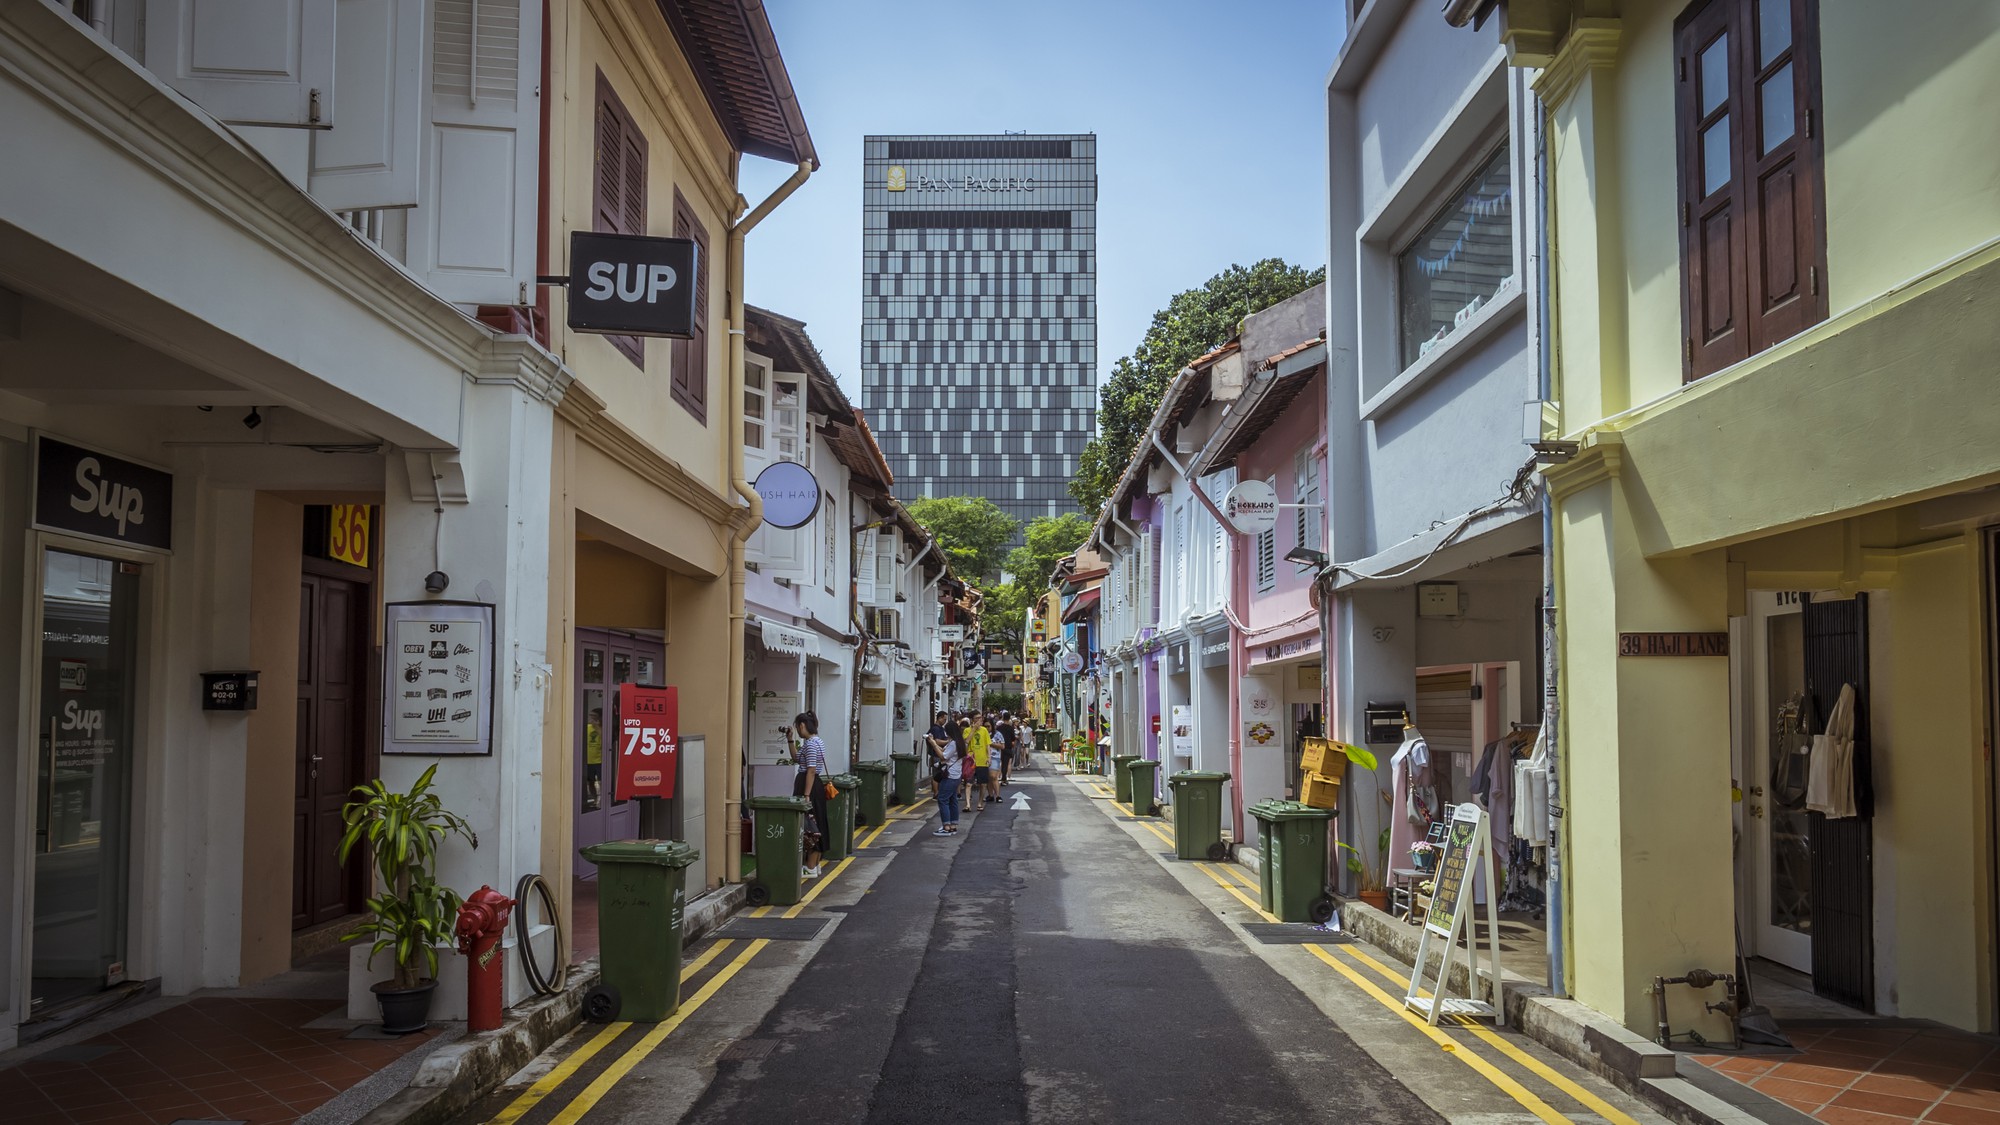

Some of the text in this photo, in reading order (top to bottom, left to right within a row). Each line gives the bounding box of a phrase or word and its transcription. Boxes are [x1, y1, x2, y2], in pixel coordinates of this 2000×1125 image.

[917, 175, 1035, 192] PAN PACIFIC
[585, 261, 677, 303] SUP
[69, 456, 144, 536] Sup
[760, 490, 816, 499] USH HAIR
[333, 504, 365, 562] 36
[429, 624, 449, 633] SUP
[1373, 626, 1395, 642] 37
[405, 645, 423, 653] OBEY
[1622, 635, 1726, 654] 39 HAJI LANE
[636, 703, 663, 712] SALE
[1253, 699, 1268, 709] 35
[61, 699, 102, 737] Sup
[428, 707, 446, 721] UH!
[658, 745, 675, 753] OFF
